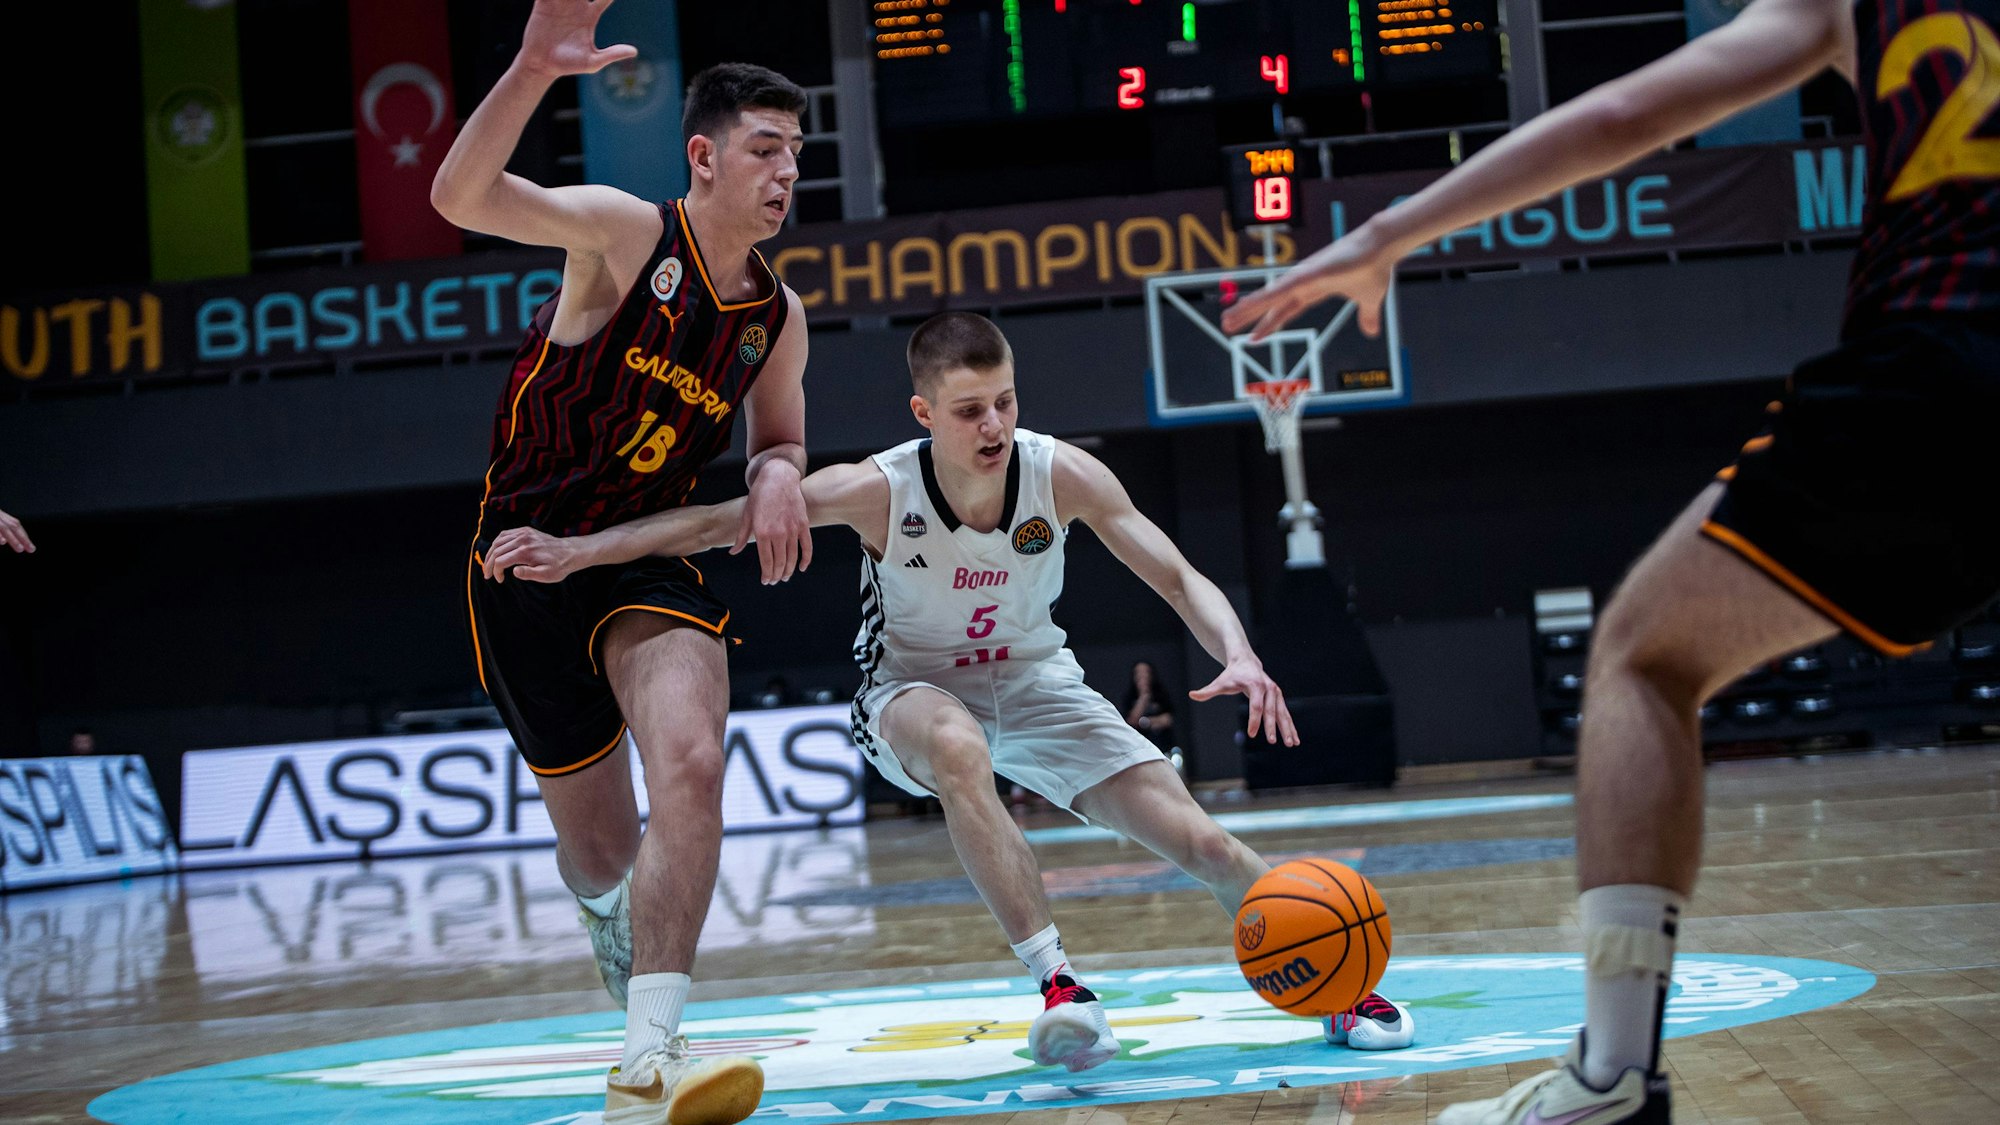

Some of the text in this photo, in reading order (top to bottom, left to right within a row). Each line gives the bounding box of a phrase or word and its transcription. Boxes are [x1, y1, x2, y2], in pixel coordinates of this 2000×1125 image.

[1118, 66, 1146, 109] 2
[1260, 54, 1289, 94] 4
[1876, 11, 2000, 202] 2
[952, 567, 1009, 590] Bonn
[966, 604, 999, 639] 5
[1247, 956, 1320, 996] Wilso
